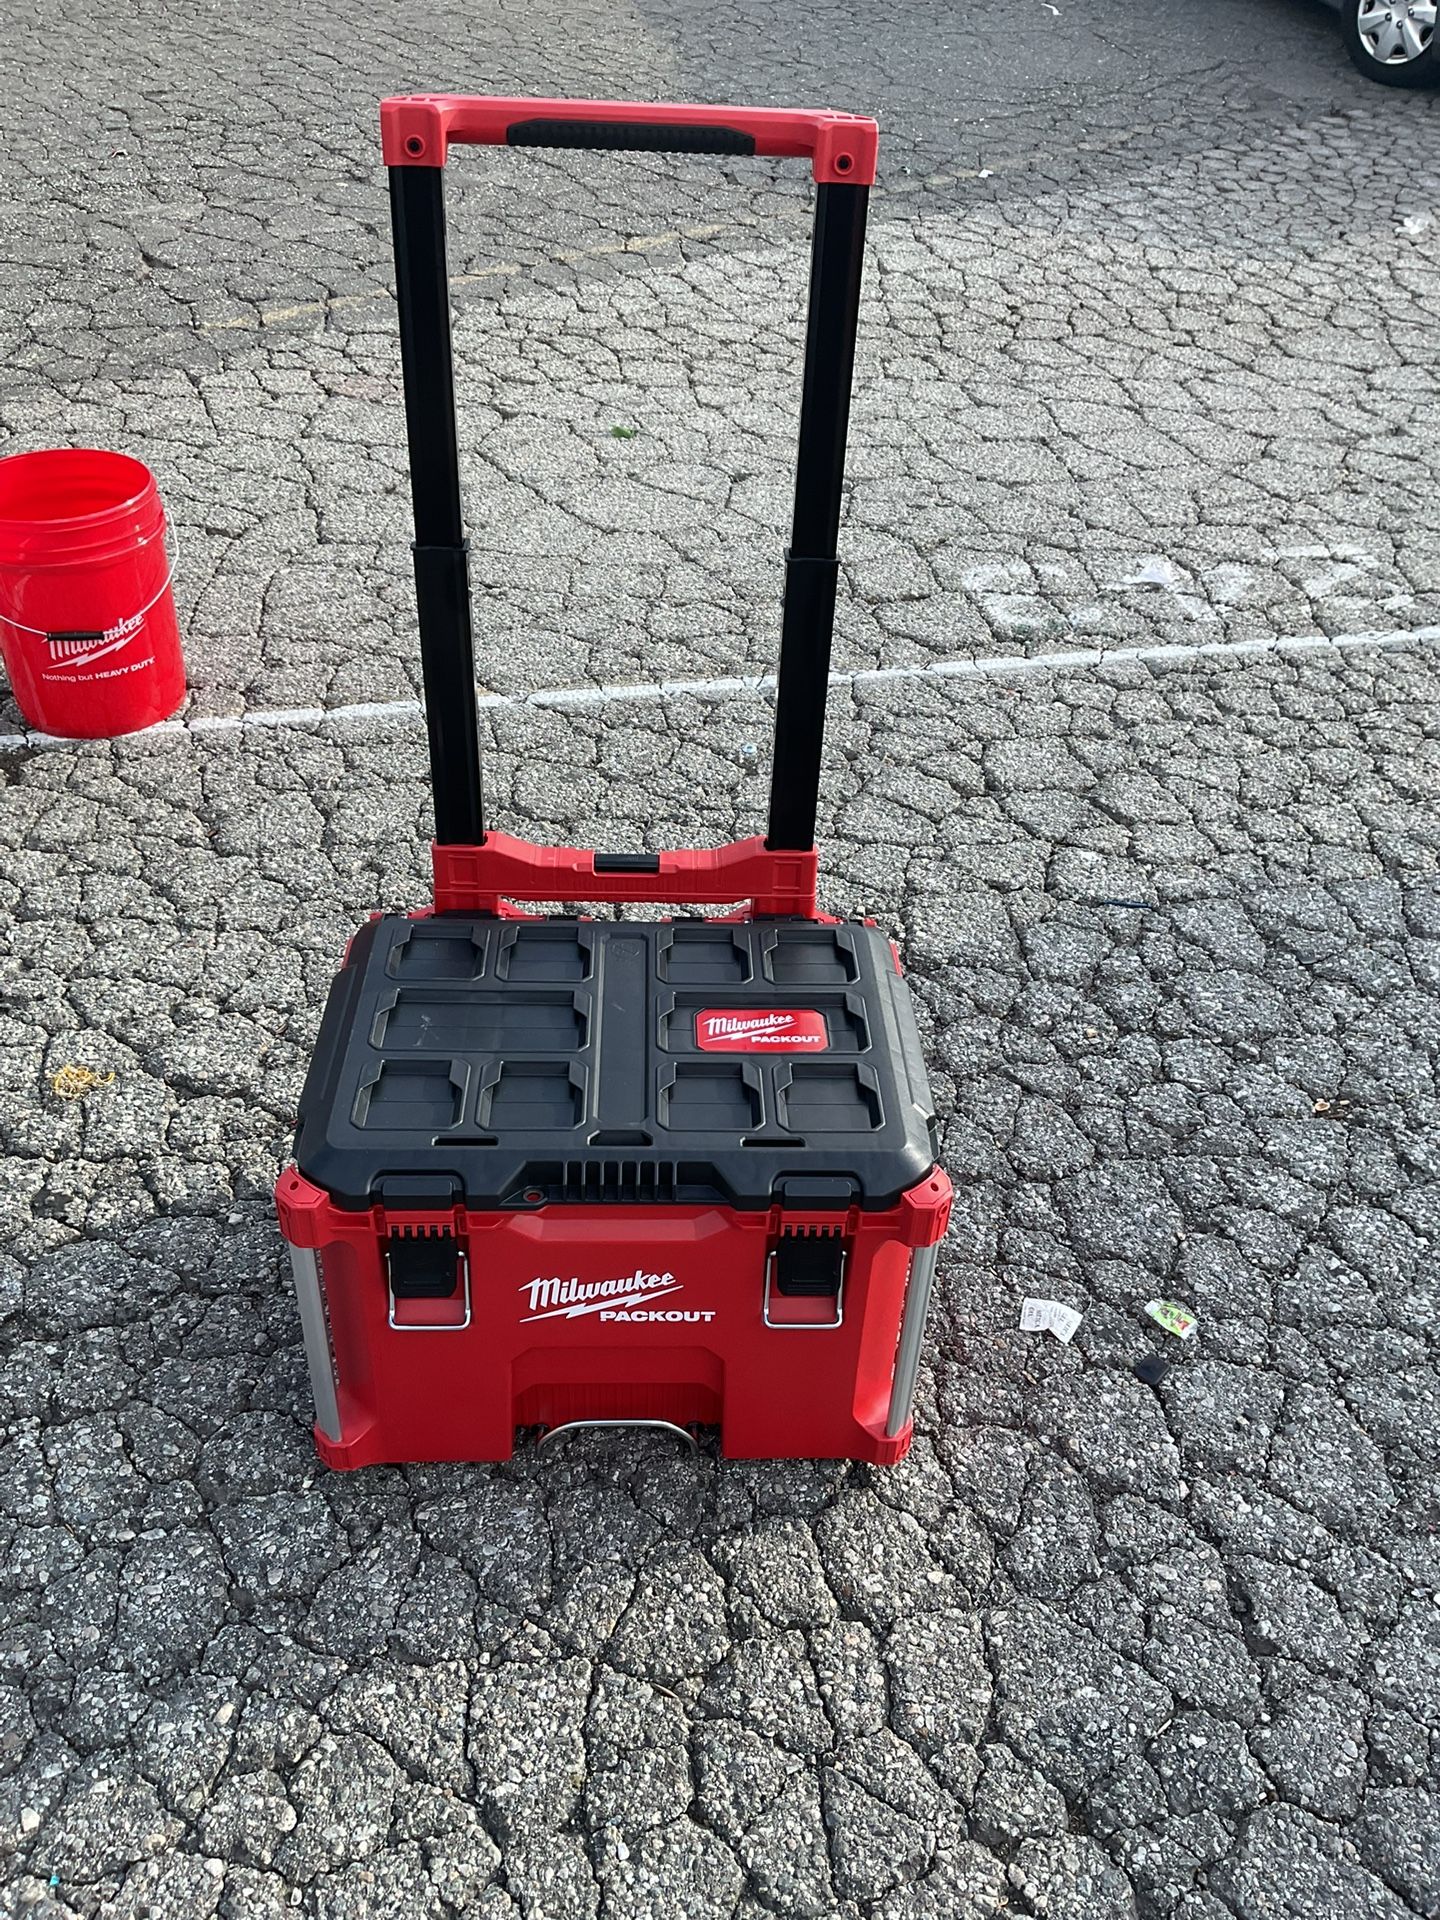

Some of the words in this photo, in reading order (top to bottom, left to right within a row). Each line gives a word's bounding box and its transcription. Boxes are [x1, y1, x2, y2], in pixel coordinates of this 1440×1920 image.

[42, 673, 76, 682] Nothing
[95, 667, 130, 680] HEAVY
[702, 1013, 795, 1036] Milwaukee
[751, 1035, 821, 1043] PACKOUT
[518, 1270, 676, 1311] Milwaukee
[599, 1310, 716, 1322] PACKOUT
